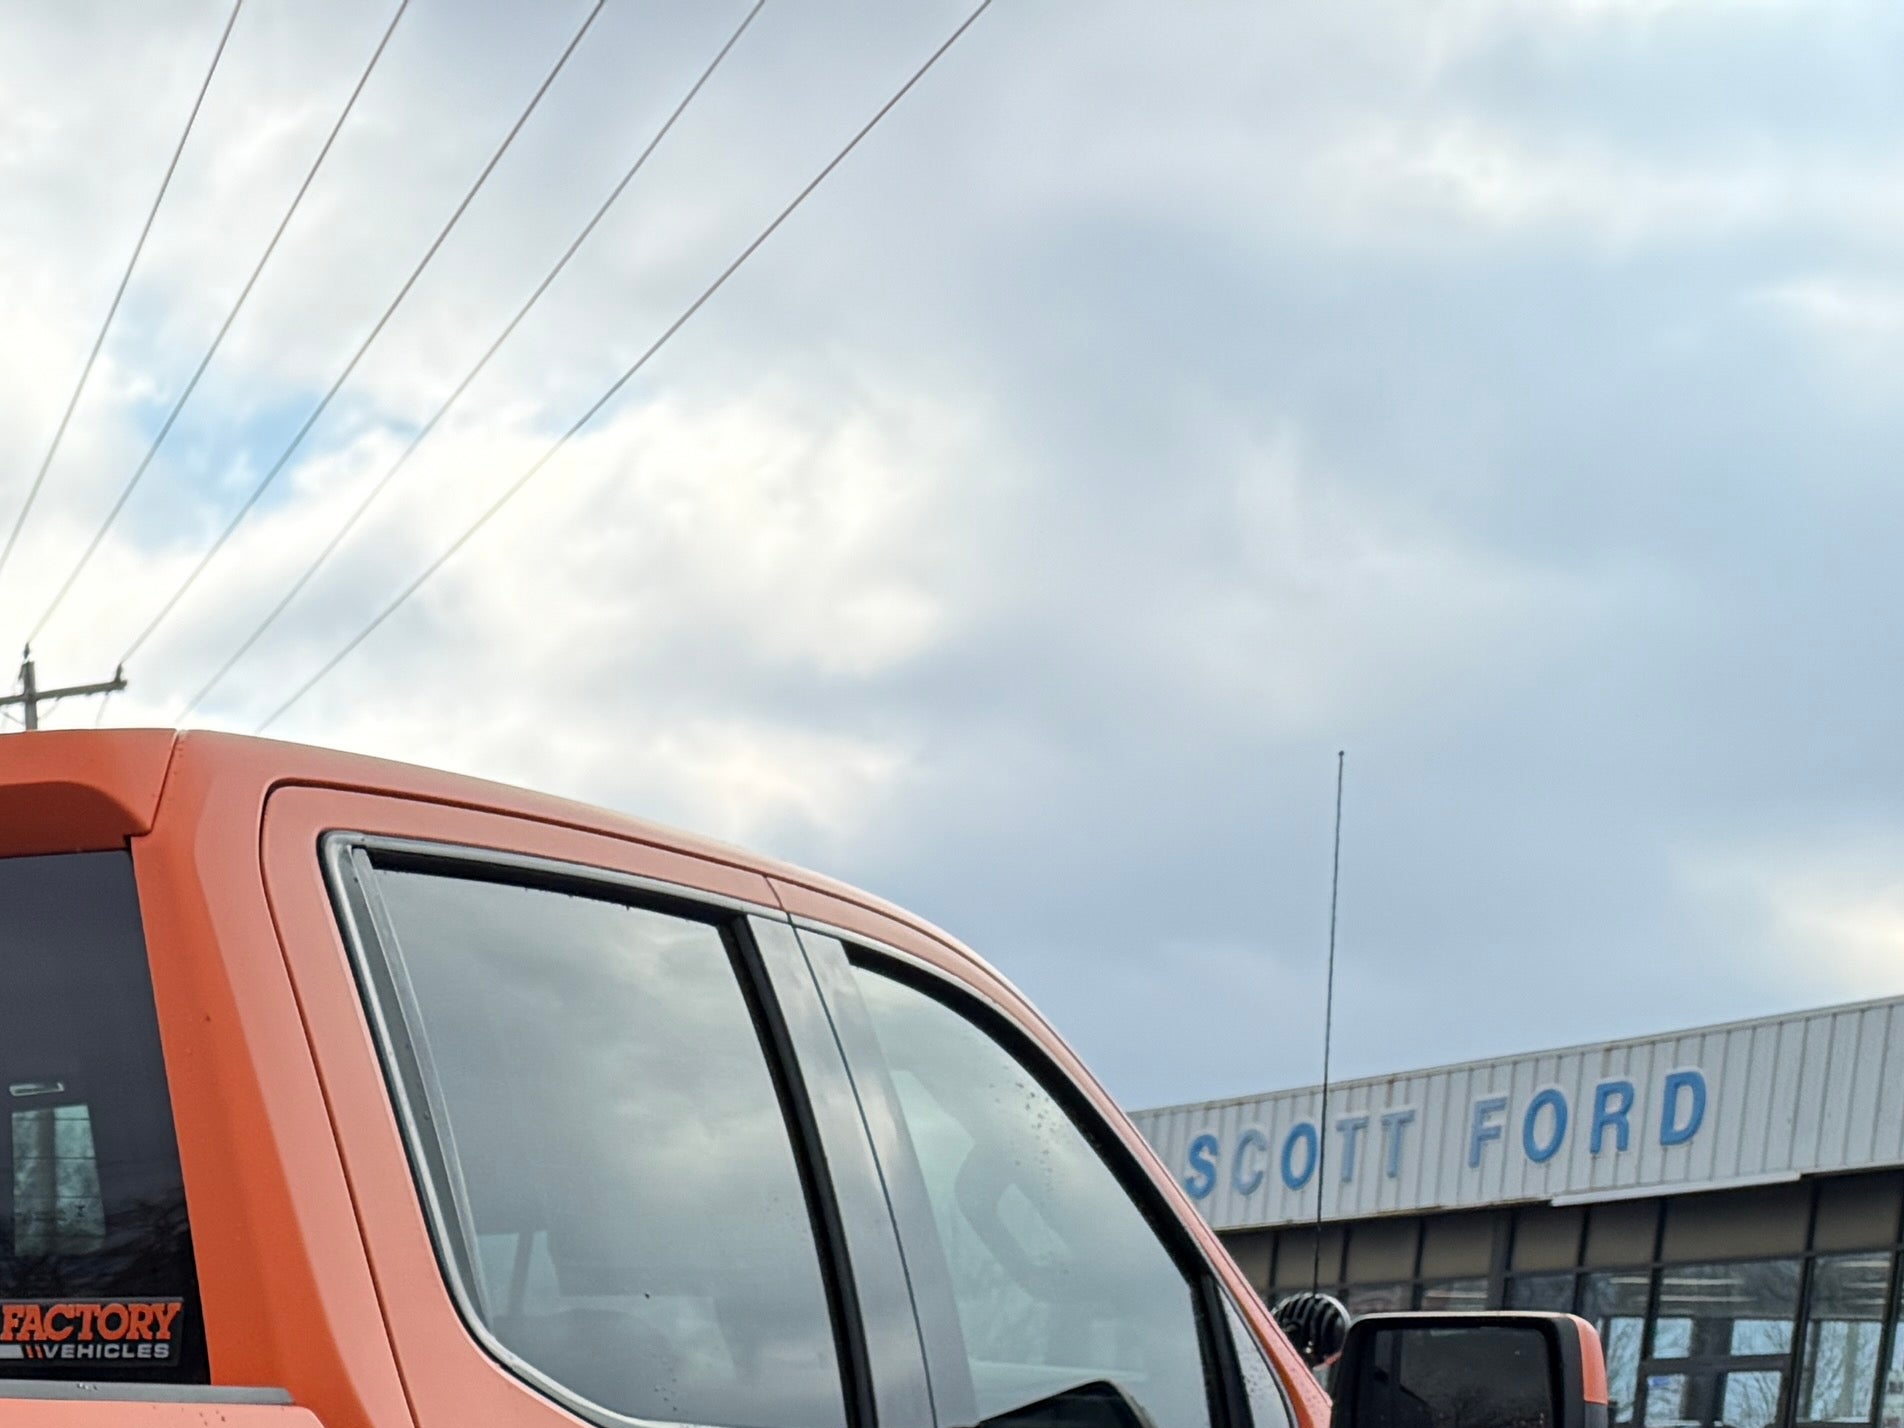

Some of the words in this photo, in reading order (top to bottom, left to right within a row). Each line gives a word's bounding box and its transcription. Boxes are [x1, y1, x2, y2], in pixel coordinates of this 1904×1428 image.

[1184, 1107, 1417, 1199] SCOTT
[1468, 1066, 1709, 1169] FORD
[0, 1302, 184, 1342] FACTORY
[44, 1343, 170, 1360] VEHICLES
